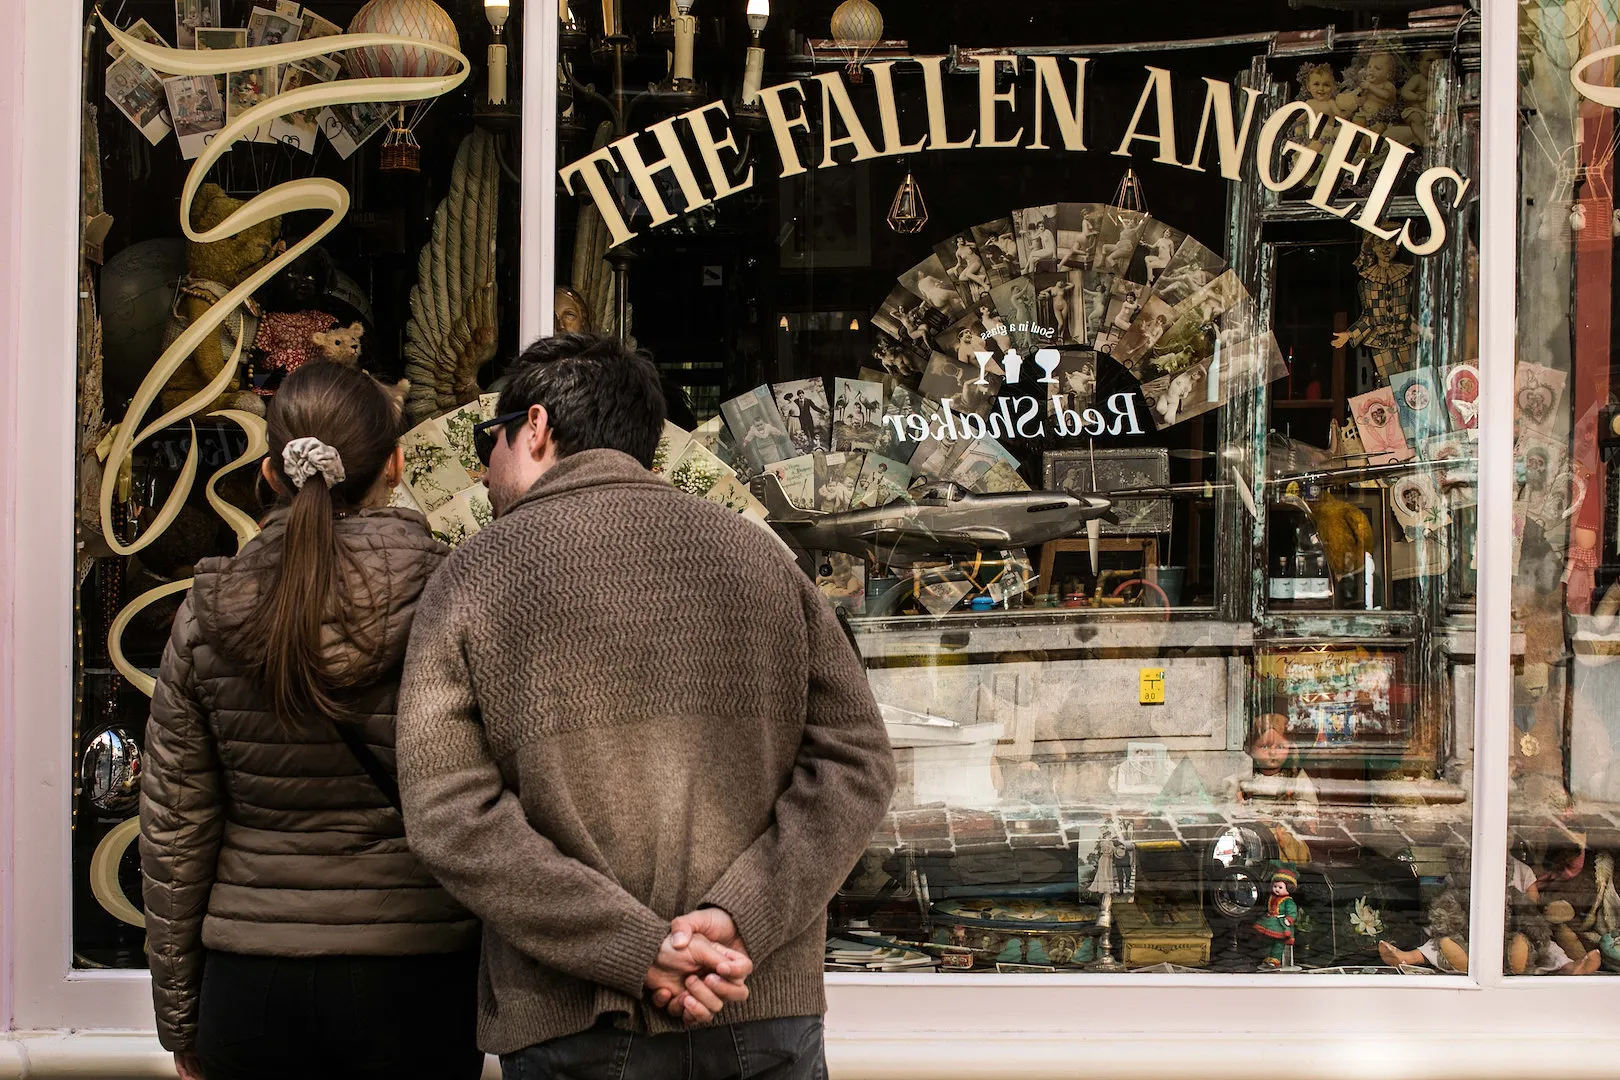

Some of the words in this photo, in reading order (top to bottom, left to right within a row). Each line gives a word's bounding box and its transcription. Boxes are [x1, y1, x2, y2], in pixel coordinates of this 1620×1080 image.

[557, 99, 755, 249] THE
[755, 54, 1091, 178] FALLEN
[1110, 64, 1471, 257] ANGELS
